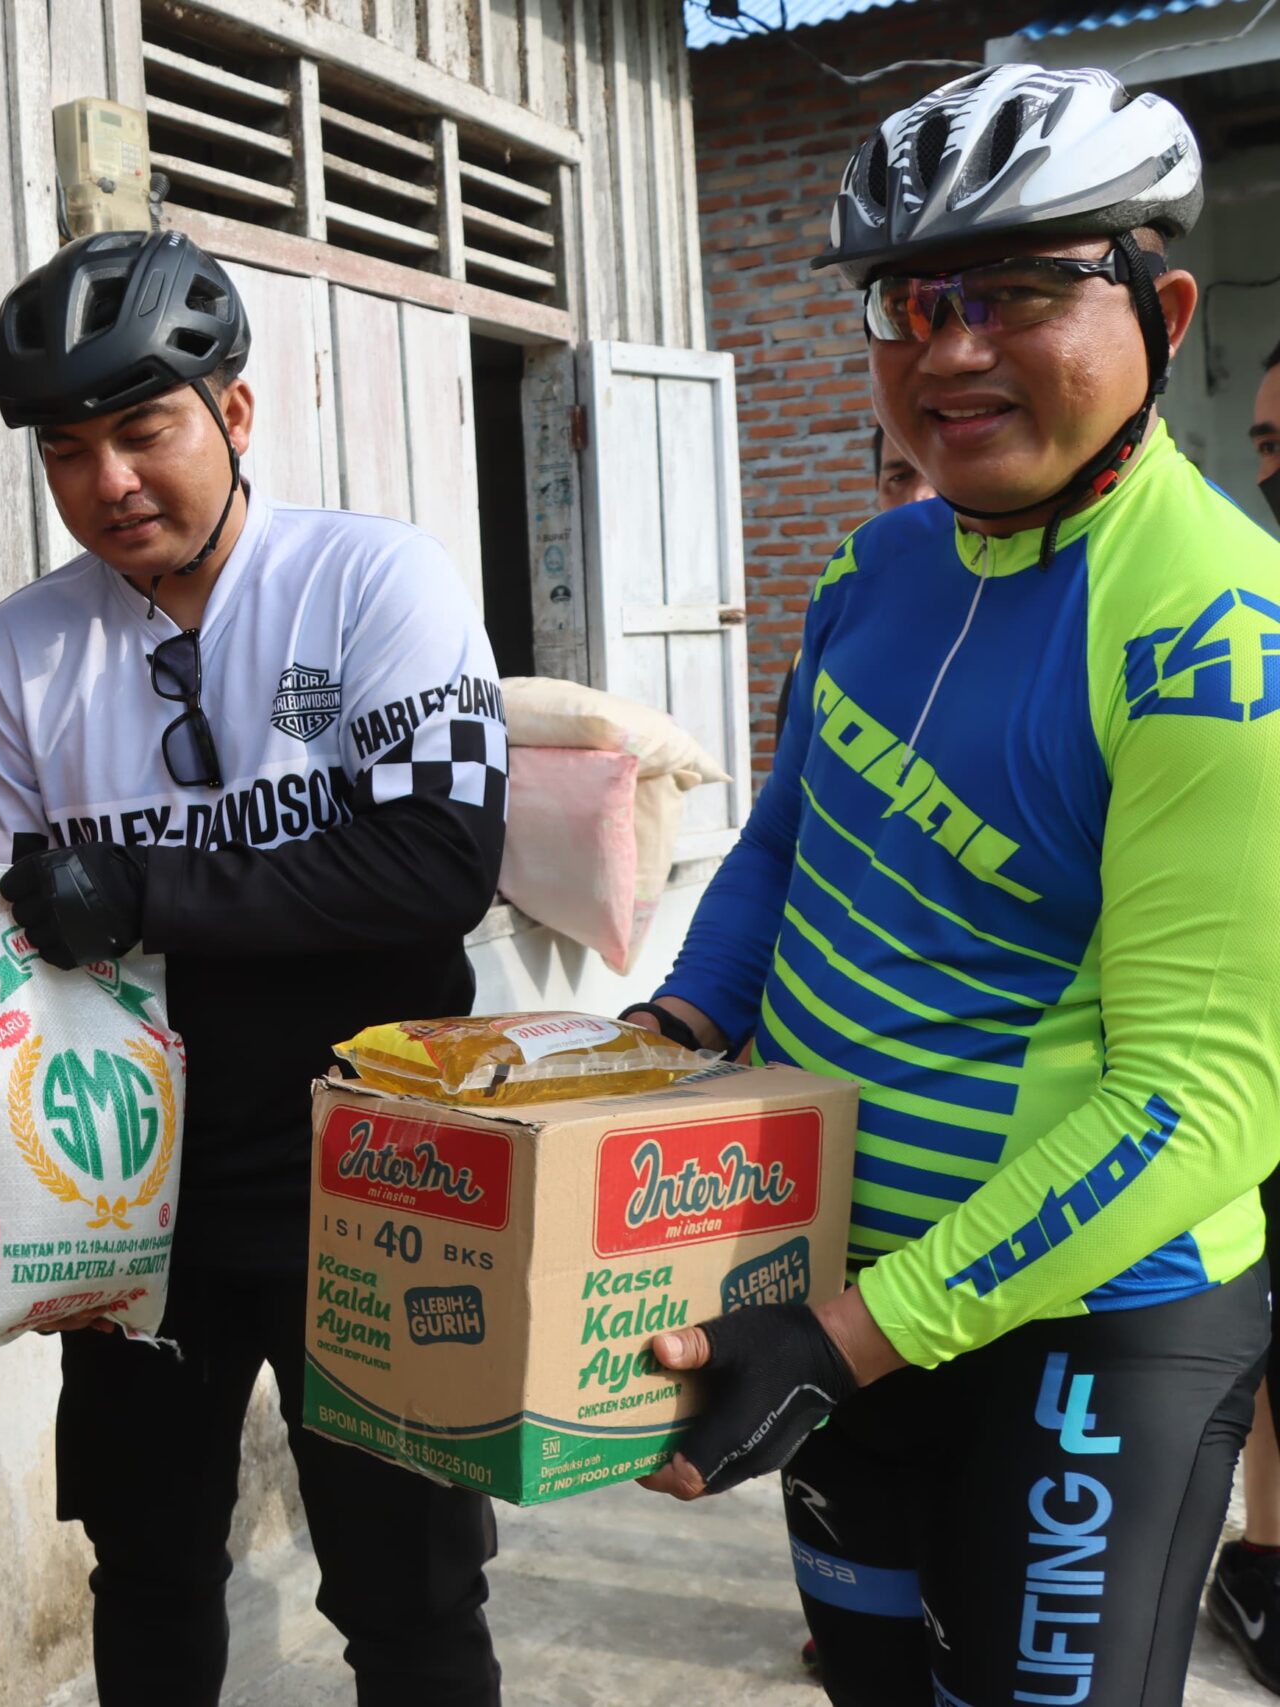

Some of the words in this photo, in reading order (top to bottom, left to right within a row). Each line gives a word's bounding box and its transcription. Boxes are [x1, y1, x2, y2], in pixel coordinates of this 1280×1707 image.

[42, 1048, 159, 1181] SMG
[338, 1118, 485, 1205] InterMi
[367, 1186, 382, 1198] mi
[382, 1186, 417, 1206] instan
[625, 1139, 796, 1229] InterMi
[373, 1220, 423, 1264] 40
[443, 1243, 495, 1271] BKS
[665, 1219, 683, 1239] mi
[683, 1217, 723, 1235] instan
[2, 1243, 54, 1258] KEMTAN
[10, 1259, 117, 1284] INDRAPURA
[126, 1253, 168, 1277] SUMUT
[317, 1252, 378, 1287] Rasa
[581, 1265, 674, 1301] Rasa
[739, 1255, 789, 1299] LEBIH
[317, 1276, 392, 1322] Kaldu
[420, 1295, 465, 1315] LEBIH
[729, 1268, 806, 1313] RIH
[316, 1307, 392, 1352] Ayam
[410, 1312, 482, 1338] GURIH
[580, 1293, 689, 1346] Kaldu
[577, 1347, 667, 1394] Aya
[577, 1398, 620, 1420] CHICKEN
[619, 1390, 645, 1410] SOUP
[643, 1383, 683, 1406] FLAVOUR
[318, 1405, 358, 1433] BPOM
[360, 1421, 373, 1440] RI
[542, 1438, 561, 1457] SNI
[538, 1481, 551, 1496] PT
[611, 1461, 632, 1477] CBP
[1013, 1471, 1114, 1706] LIFTING
